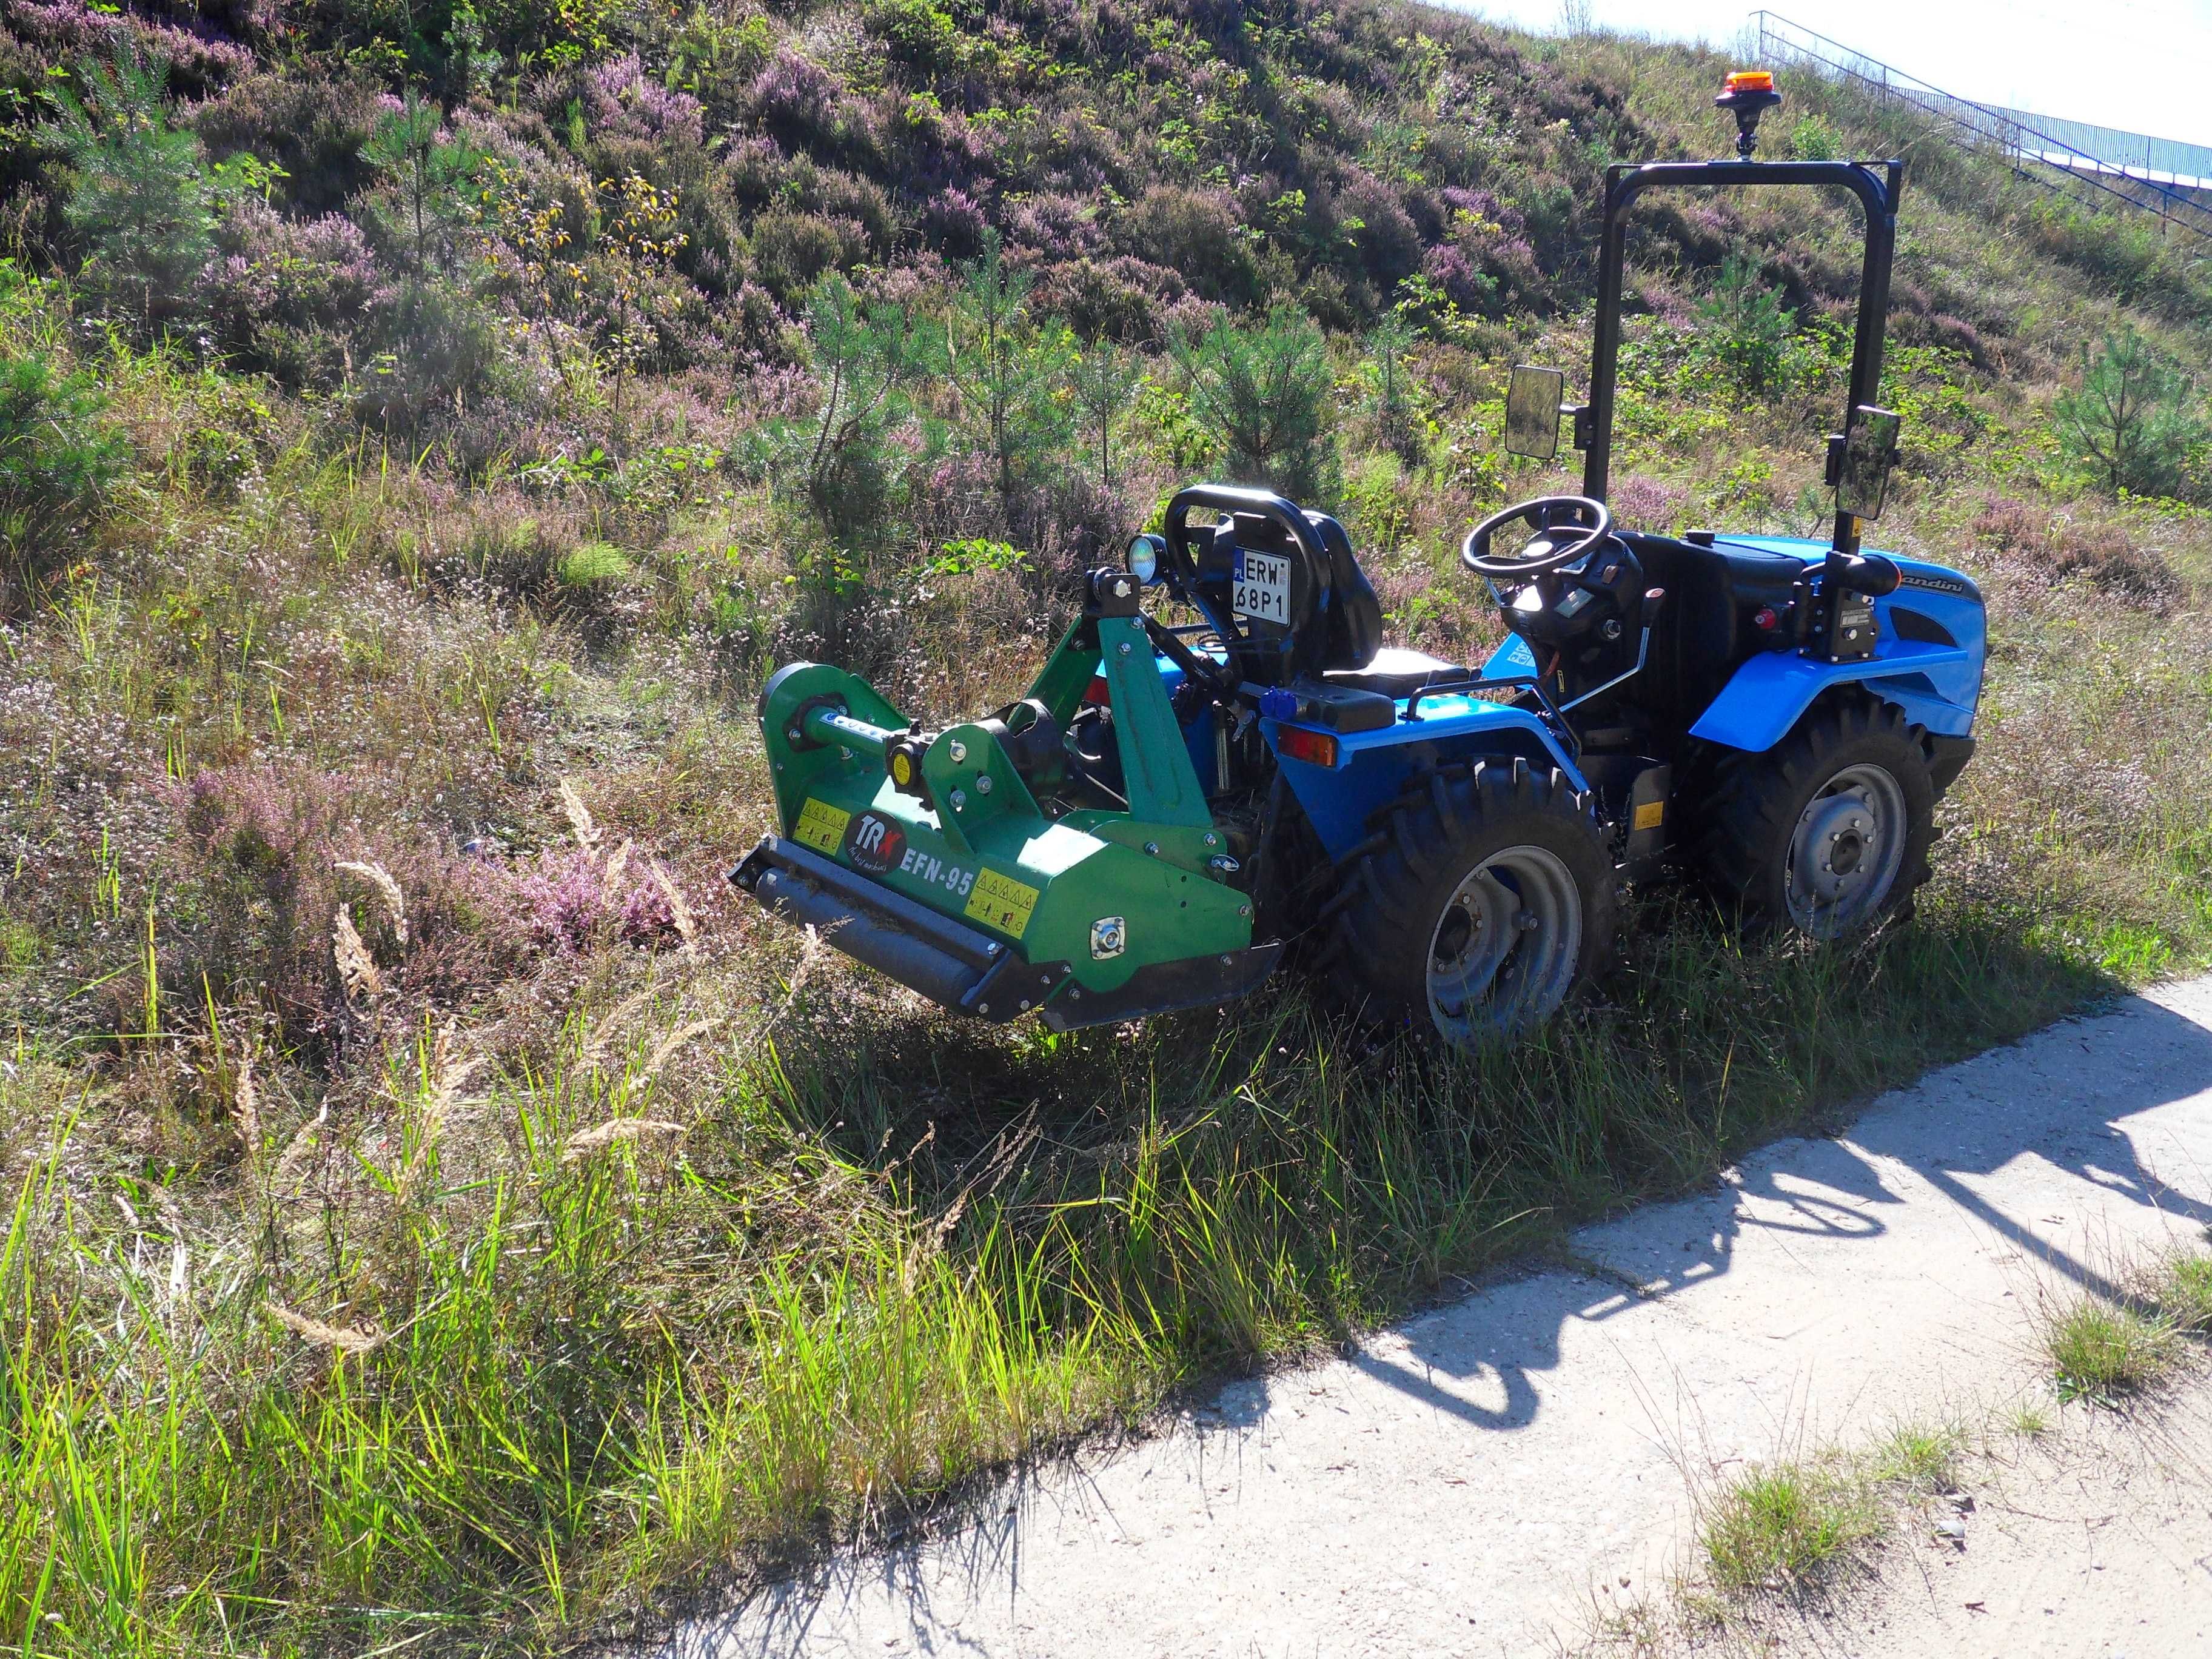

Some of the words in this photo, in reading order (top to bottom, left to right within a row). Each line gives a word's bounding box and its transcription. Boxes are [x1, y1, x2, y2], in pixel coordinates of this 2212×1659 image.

[1234, 568, 1244, 580] PL
[1246, 557, 1278, 586] ERW
[1900, 577, 1964, 592] andini
[1237, 586, 1282, 617] 68P1
[900, 848, 974, 896] EFN-95
